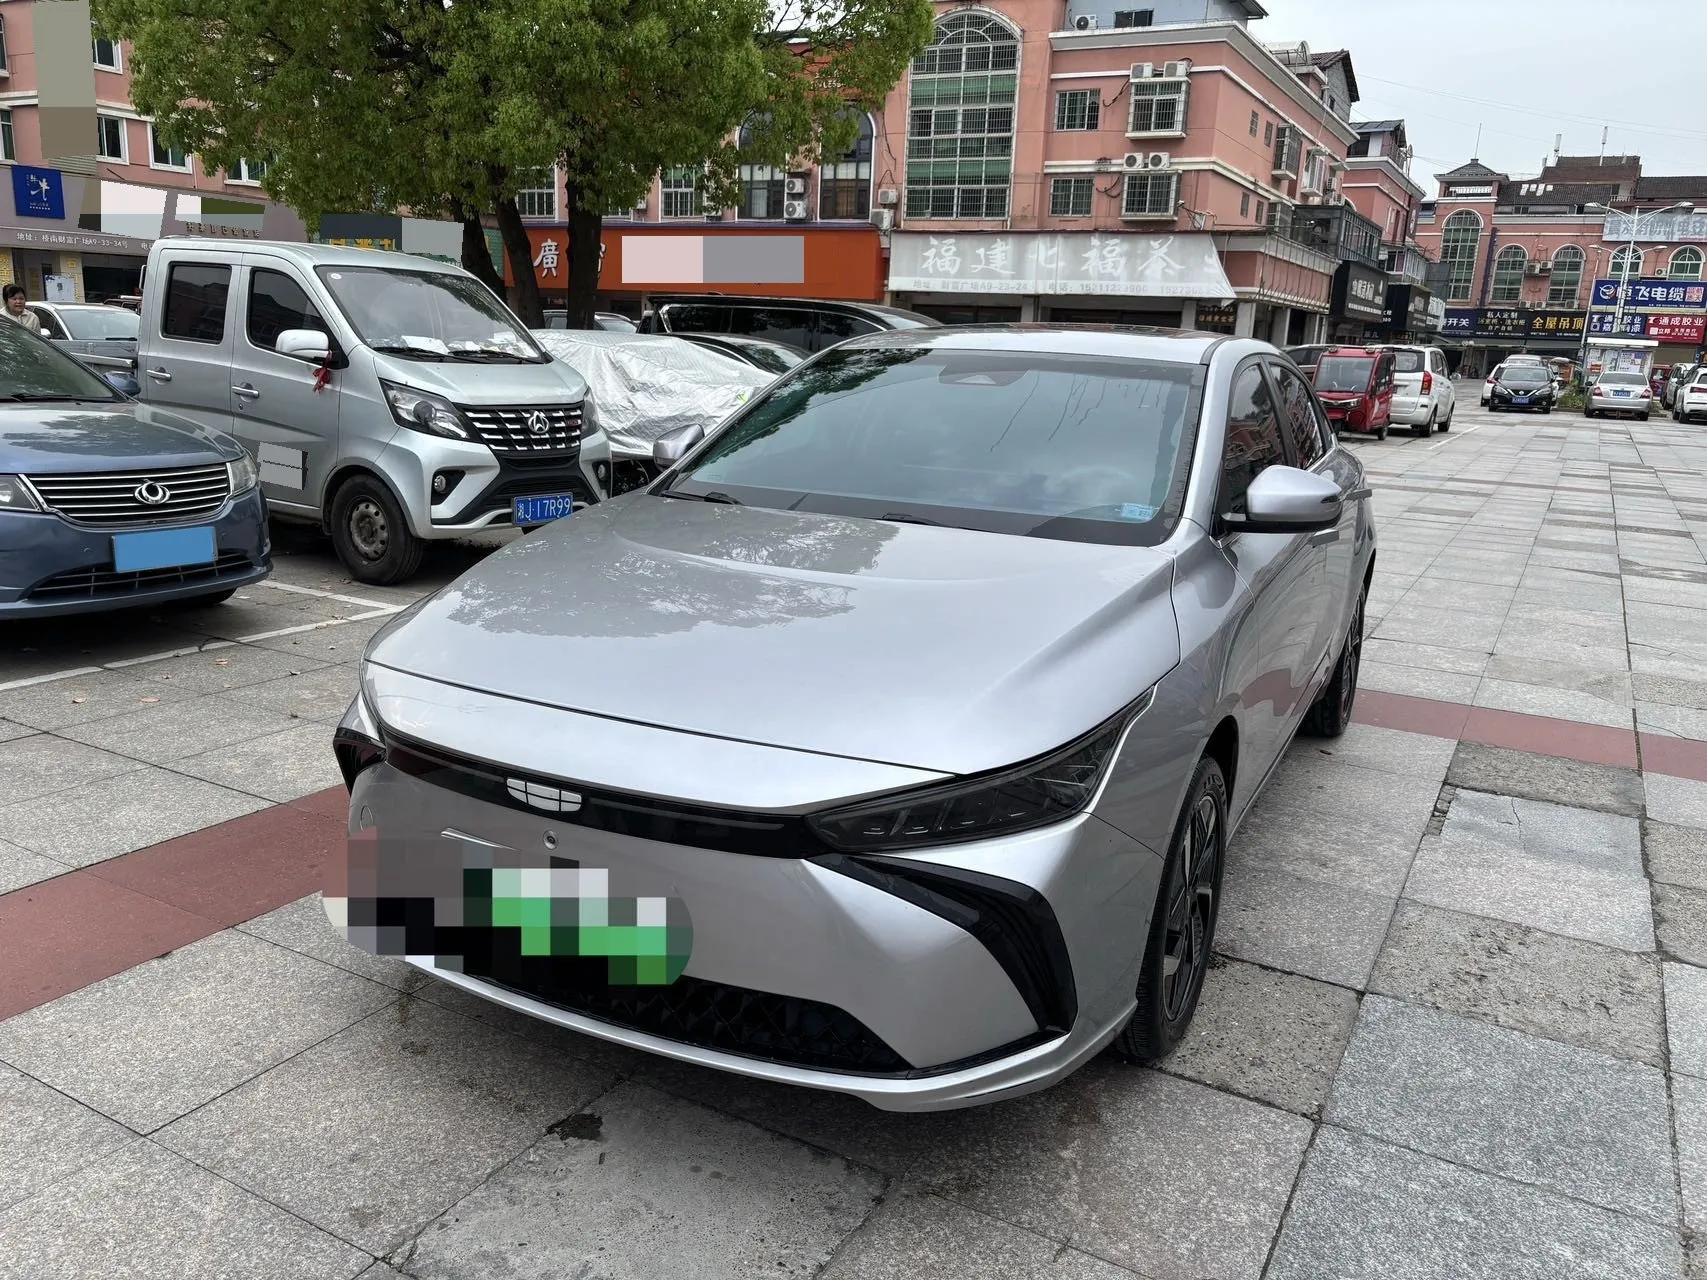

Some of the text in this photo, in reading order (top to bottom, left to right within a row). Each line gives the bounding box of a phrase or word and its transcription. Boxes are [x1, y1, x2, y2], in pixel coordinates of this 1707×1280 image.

[1486, 311, 1518, 319] 私人定制
[1604, 315, 1641, 325] 通胶业
[1531, 316, 1585, 331] 全屋吊顶
[1659, 317, 1704, 327] 通成胶业
